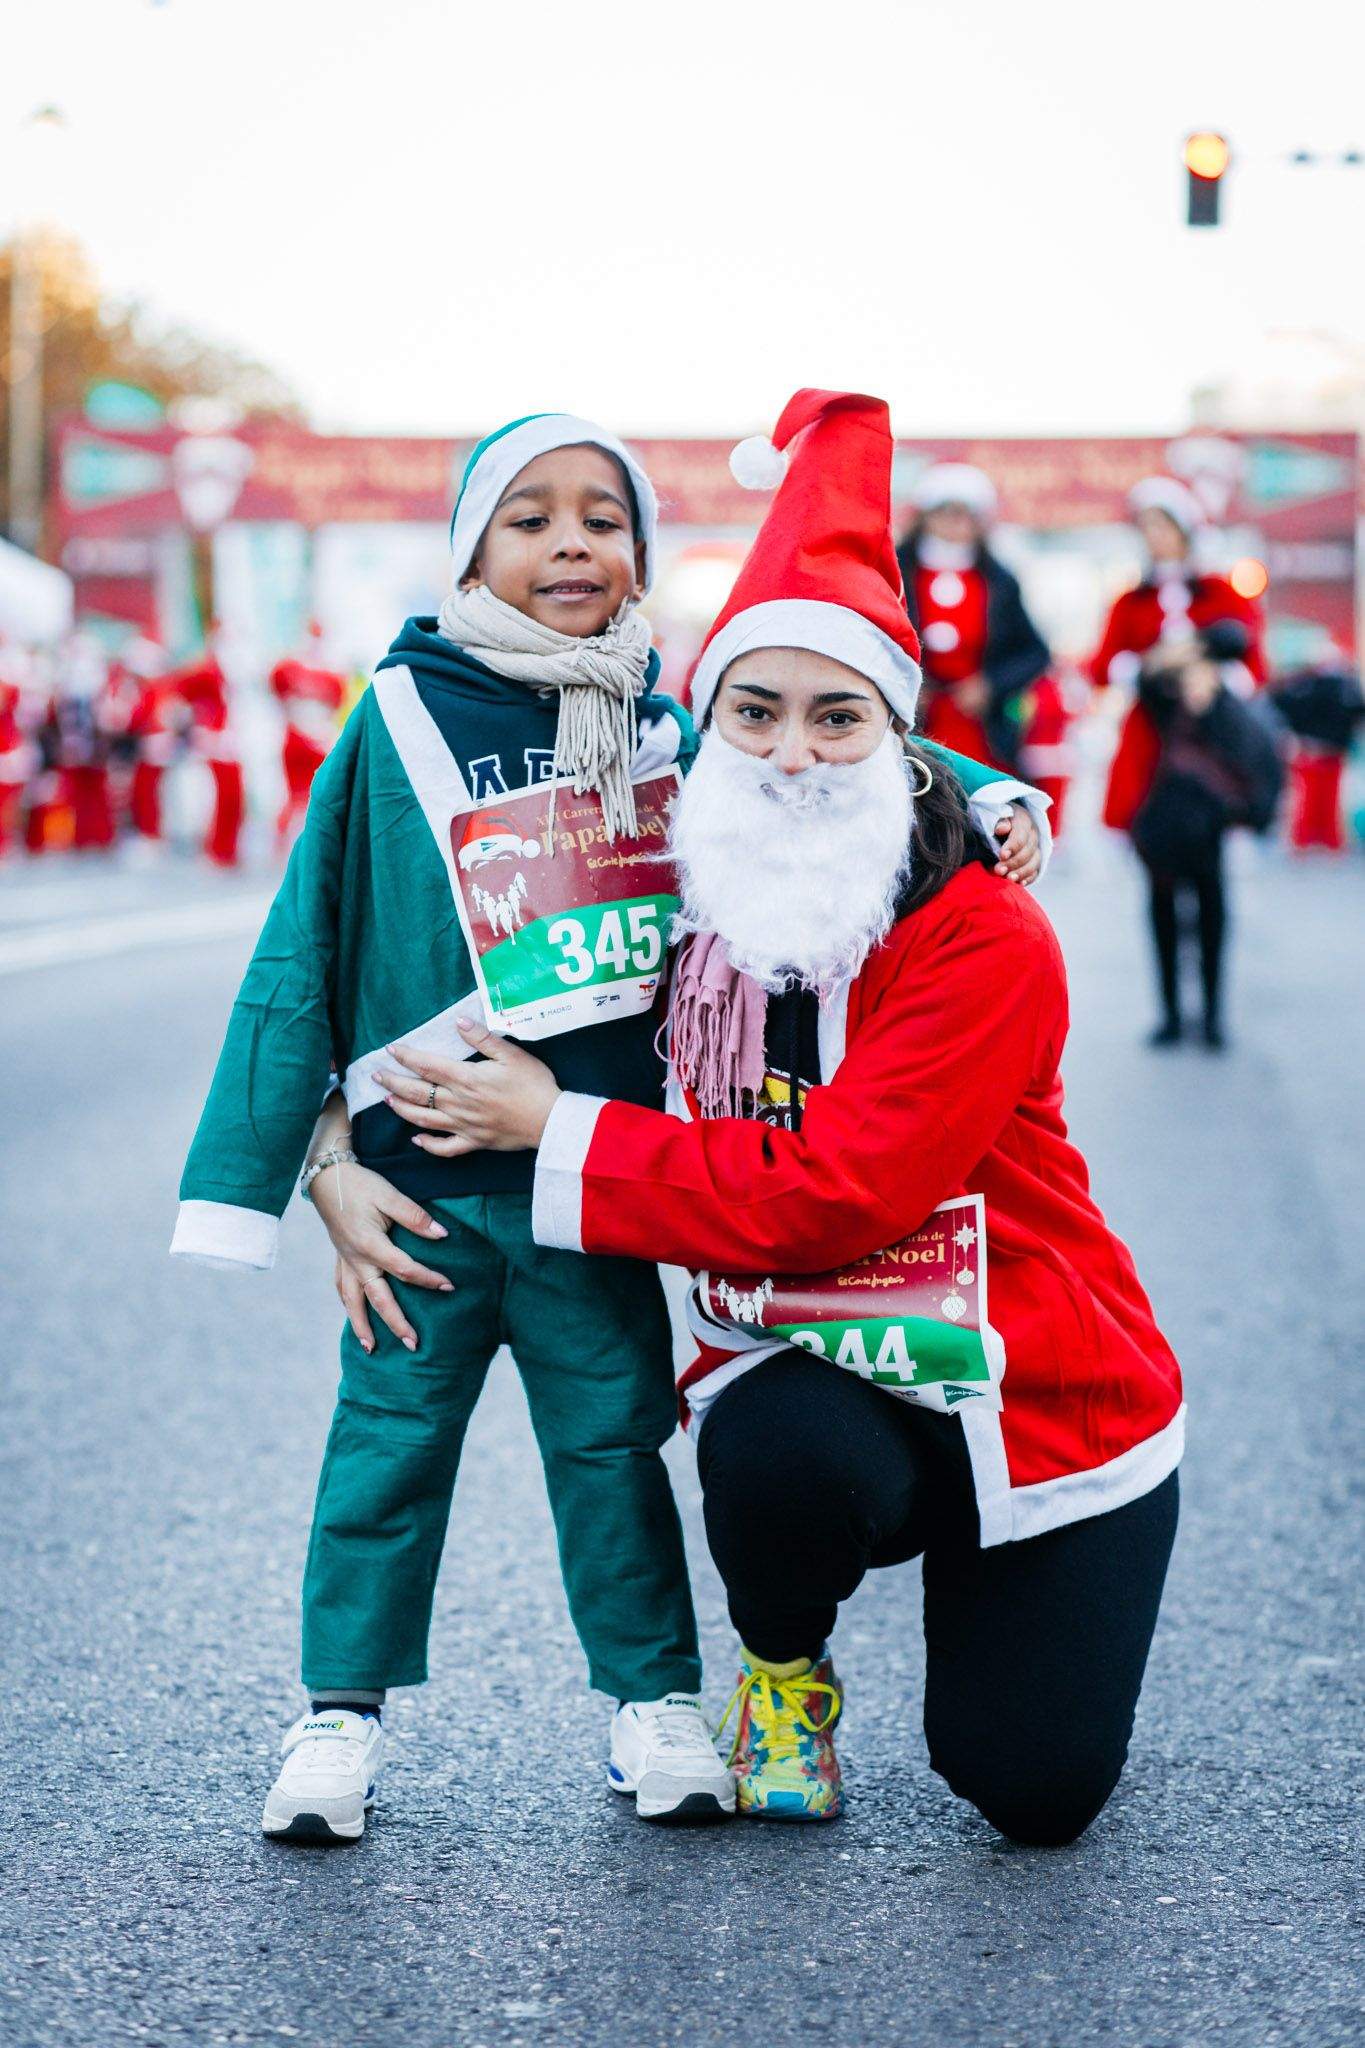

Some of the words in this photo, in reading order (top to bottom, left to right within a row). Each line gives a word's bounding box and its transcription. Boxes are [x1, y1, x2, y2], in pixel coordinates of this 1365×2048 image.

[563, 805, 603, 820] Carrer
[636, 814, 667, 838] oel
[547, 903, 662, 986] 345
[931, 1231, 946, 1241] de
[879, 1242, 946, 1265] Noel
[303, 1722, 340, 1731] SONIC
